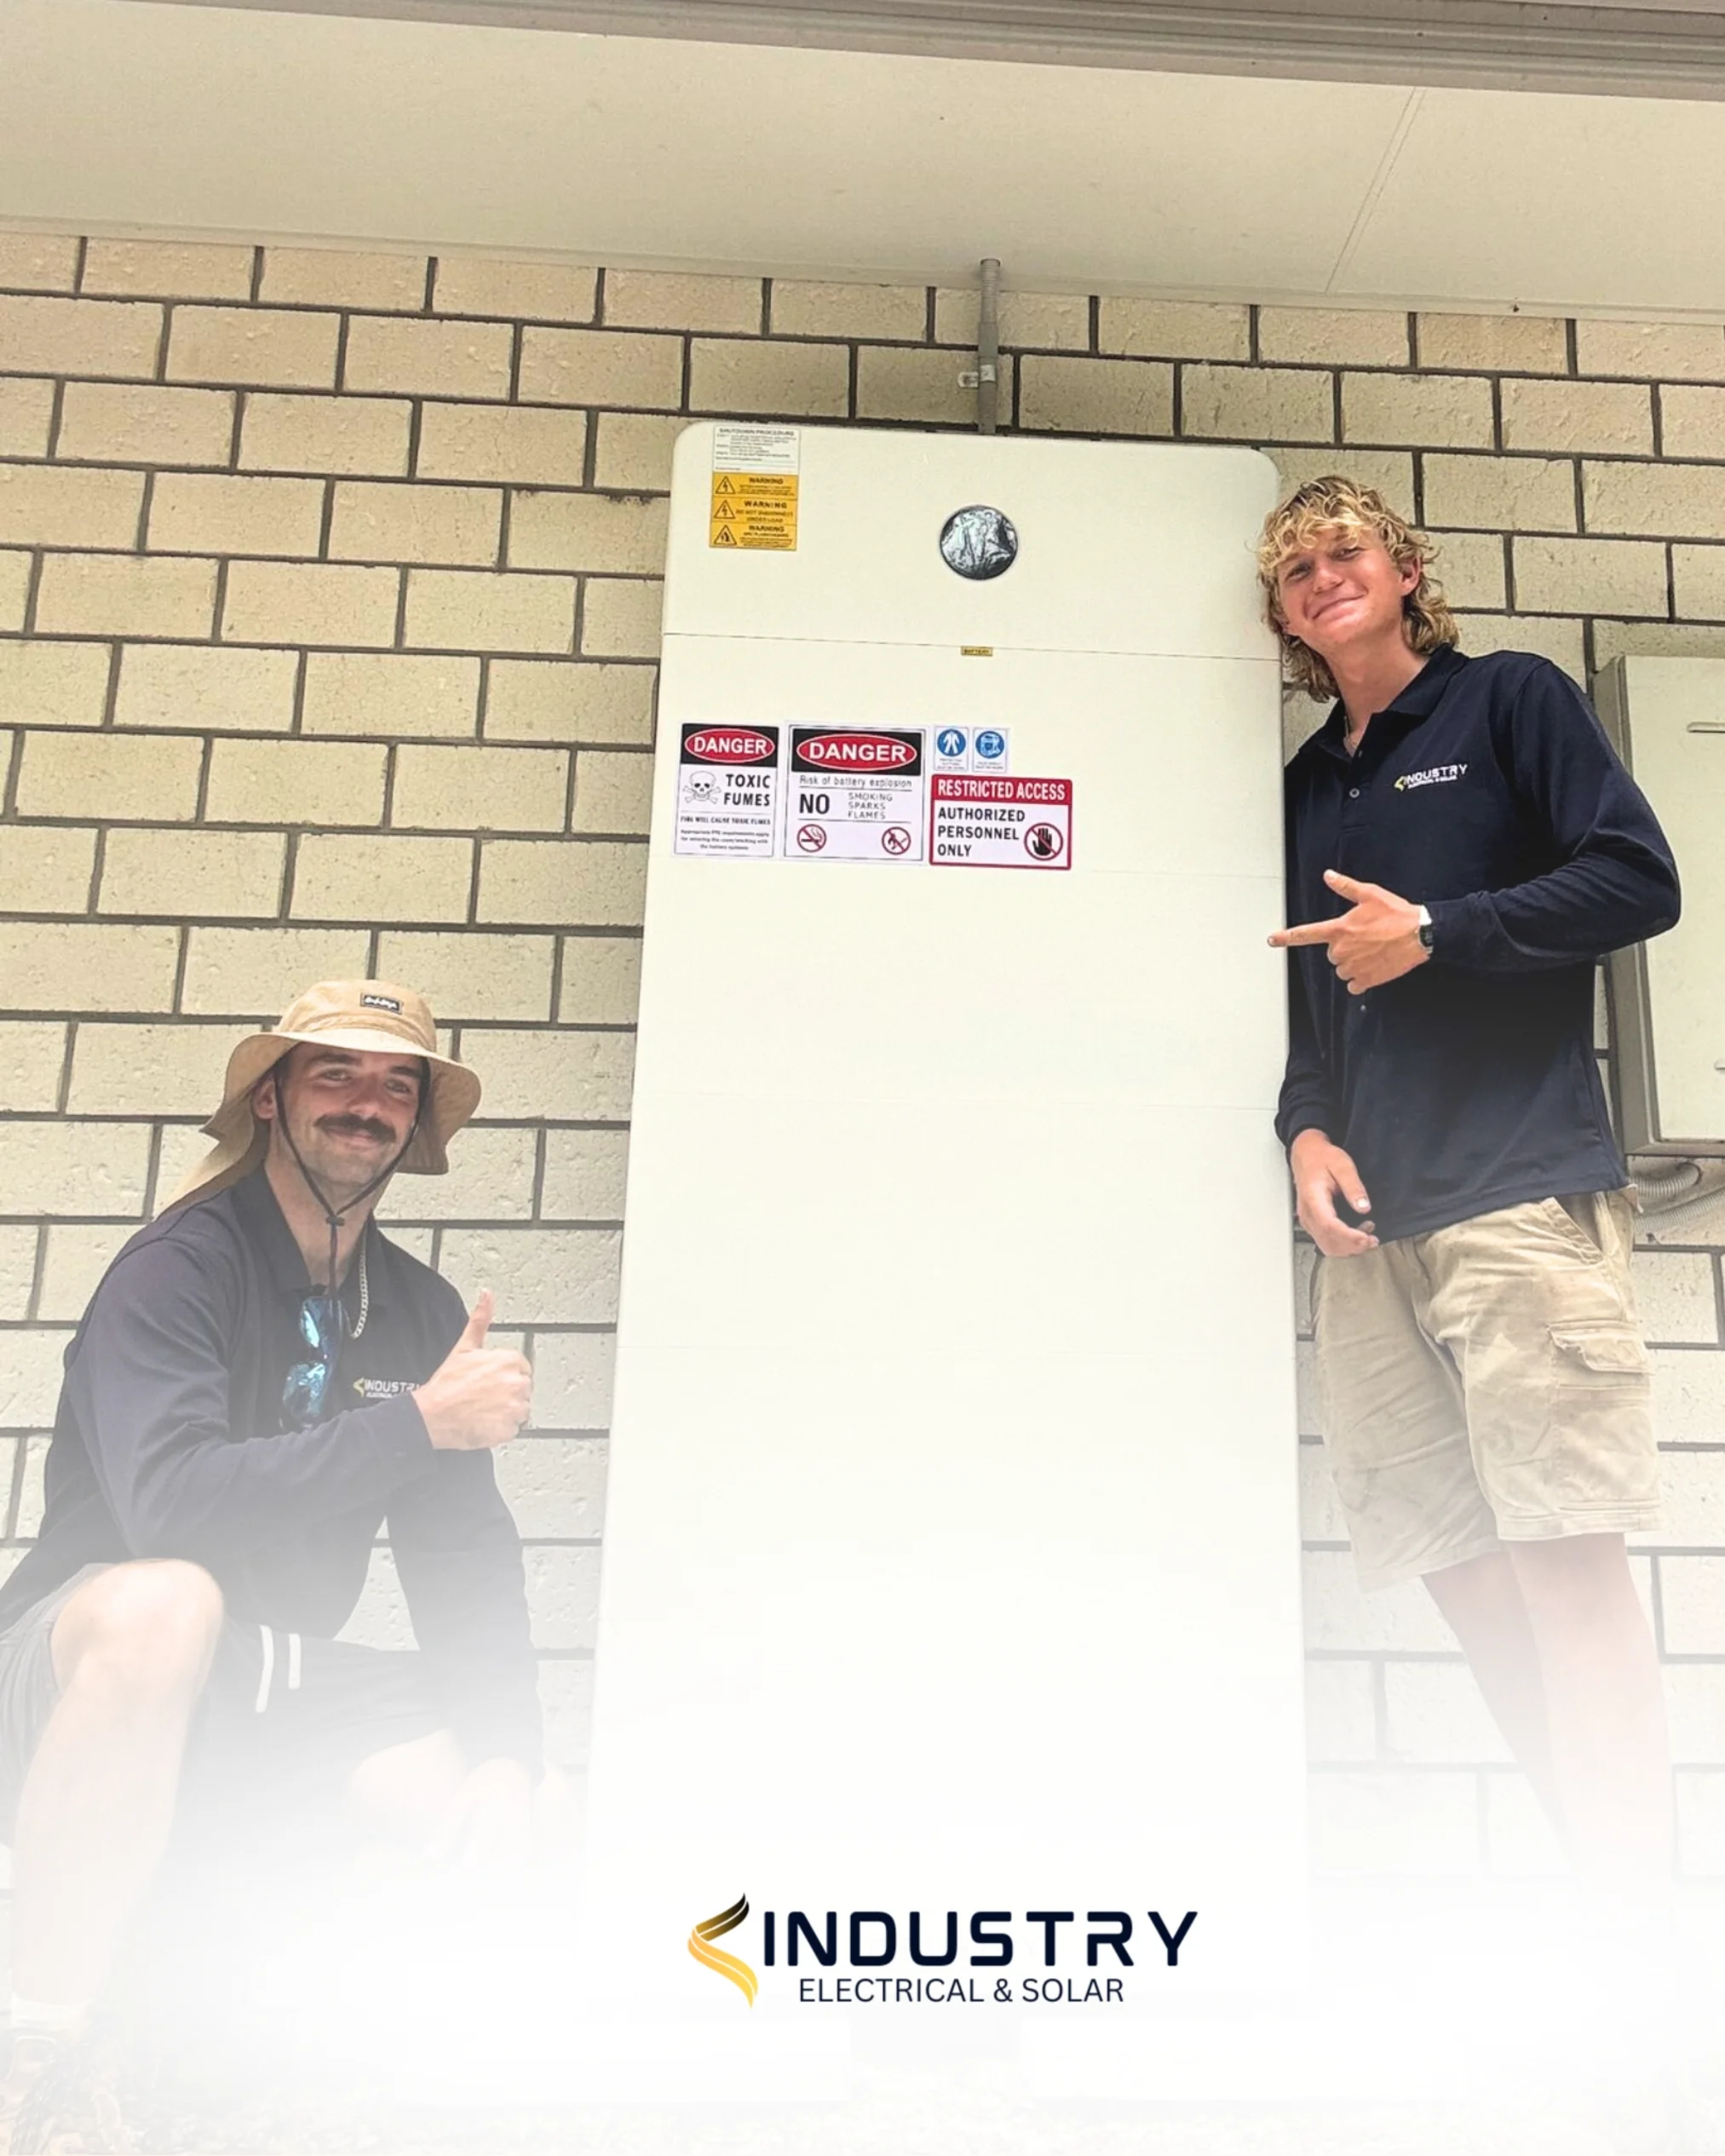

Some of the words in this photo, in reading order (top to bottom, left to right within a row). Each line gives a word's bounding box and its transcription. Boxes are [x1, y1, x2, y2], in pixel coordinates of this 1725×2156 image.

[744, 500, 787, 509] WARNING
[693, 737, 767, 756] DANGER
[809, 742, 906, 762] DANGER
[726, 773, 771, 789] TOXIC
[800, 775, 818, 785] Risk
[822, 776, 831, 785] of
[834, 777, 865, 789] battery
[869, 778, 912, 788] explosion
[848, 792, 893, 802] SMOKING
[938, 779, 1014, 798] RESTRICTED
[1016, 782, 1066, 800] ACCESS
[723, 792, 770, 807] FUMES
[799, 793, 830, 814] NO
[848, 802, 886, 810] SPARKS
[848, 810, 886, 819] FLAMES
[938, 807, 1026, 822] AUTHORIZED
[938, 825, 1020, 840] PERSONNEL
[937, 843, 972, 857] ONLY
